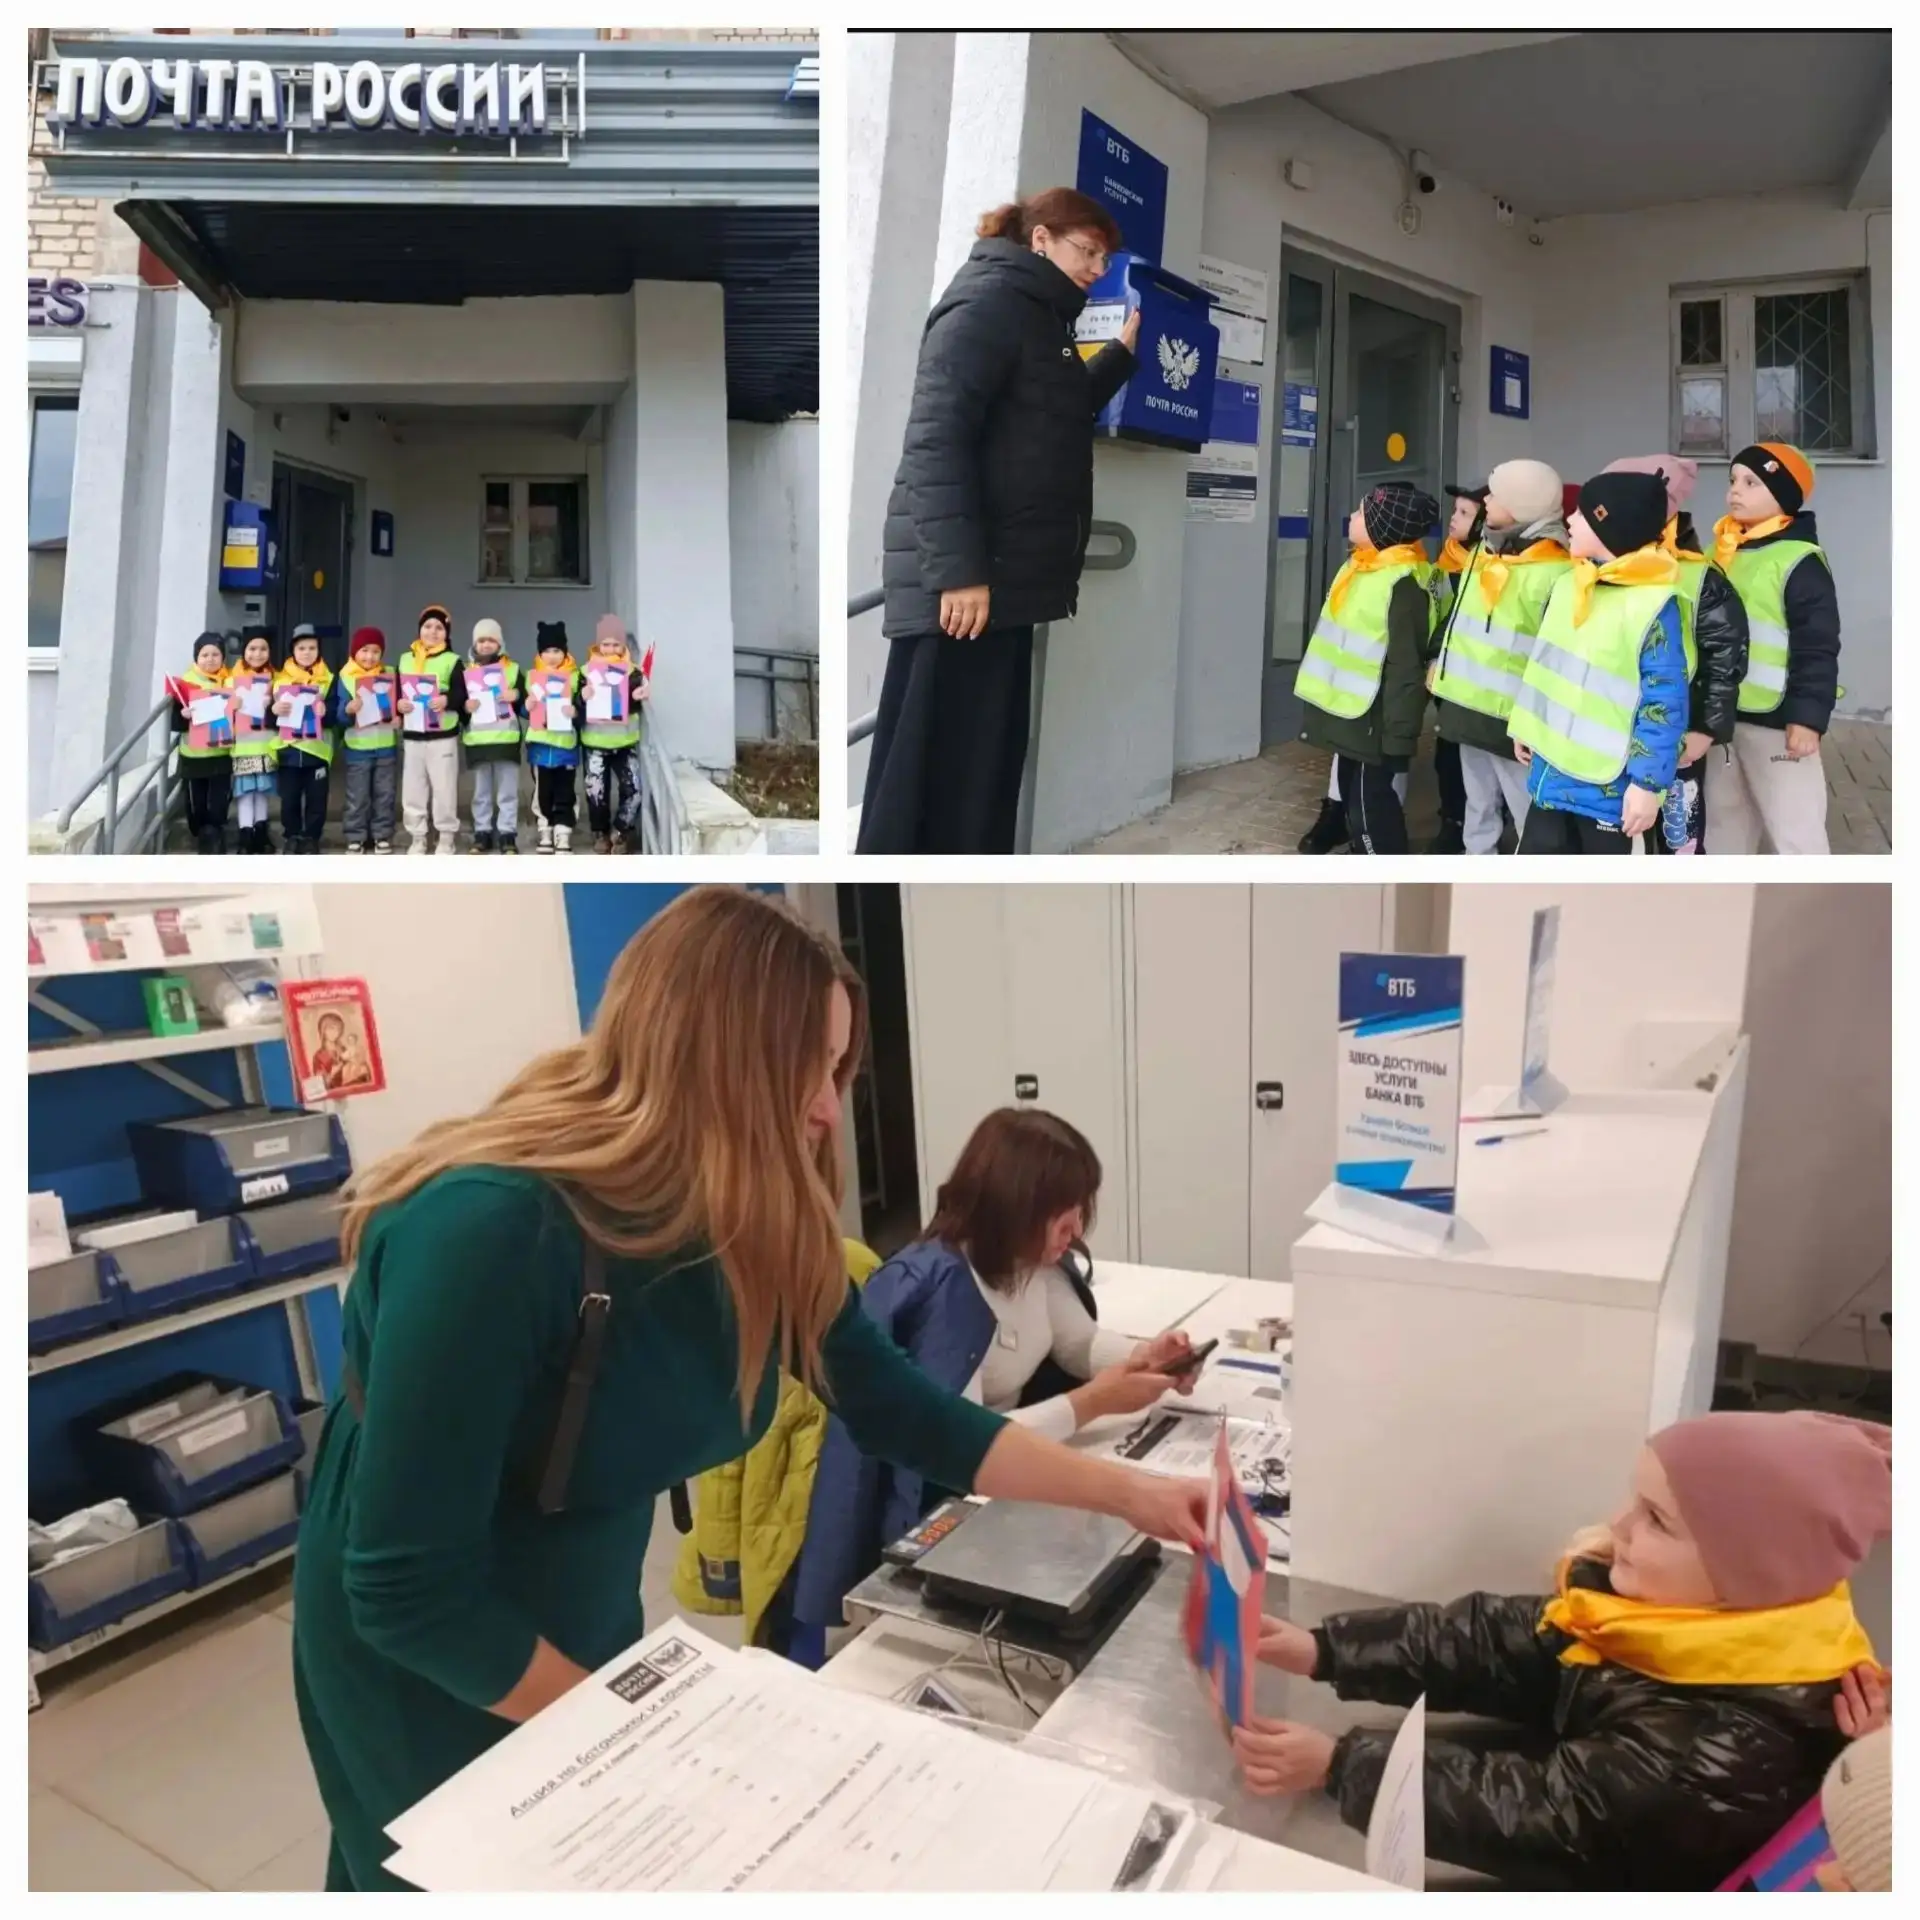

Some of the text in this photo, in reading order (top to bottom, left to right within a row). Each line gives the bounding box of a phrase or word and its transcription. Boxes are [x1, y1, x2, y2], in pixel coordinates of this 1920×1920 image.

[56, 57, 547, 132] ПОЧТА РОССИИ
[1107, 137, 1130, 164] ВТБ
[1145, 394, 1199, 419] ПОЧТА РОССИИ
[1388, 977, 1416, 998] ВТБ
[1348, 1050, 1448, 1076] ЗДЕСЬ ДОСТУПНЫ
[1374, 1071, 1418, 1090] УСЛУГИ
[1365, 1086, 1426, 1109] БАНКА ВТБ
[510, 1780, 557, 1819] Акция
